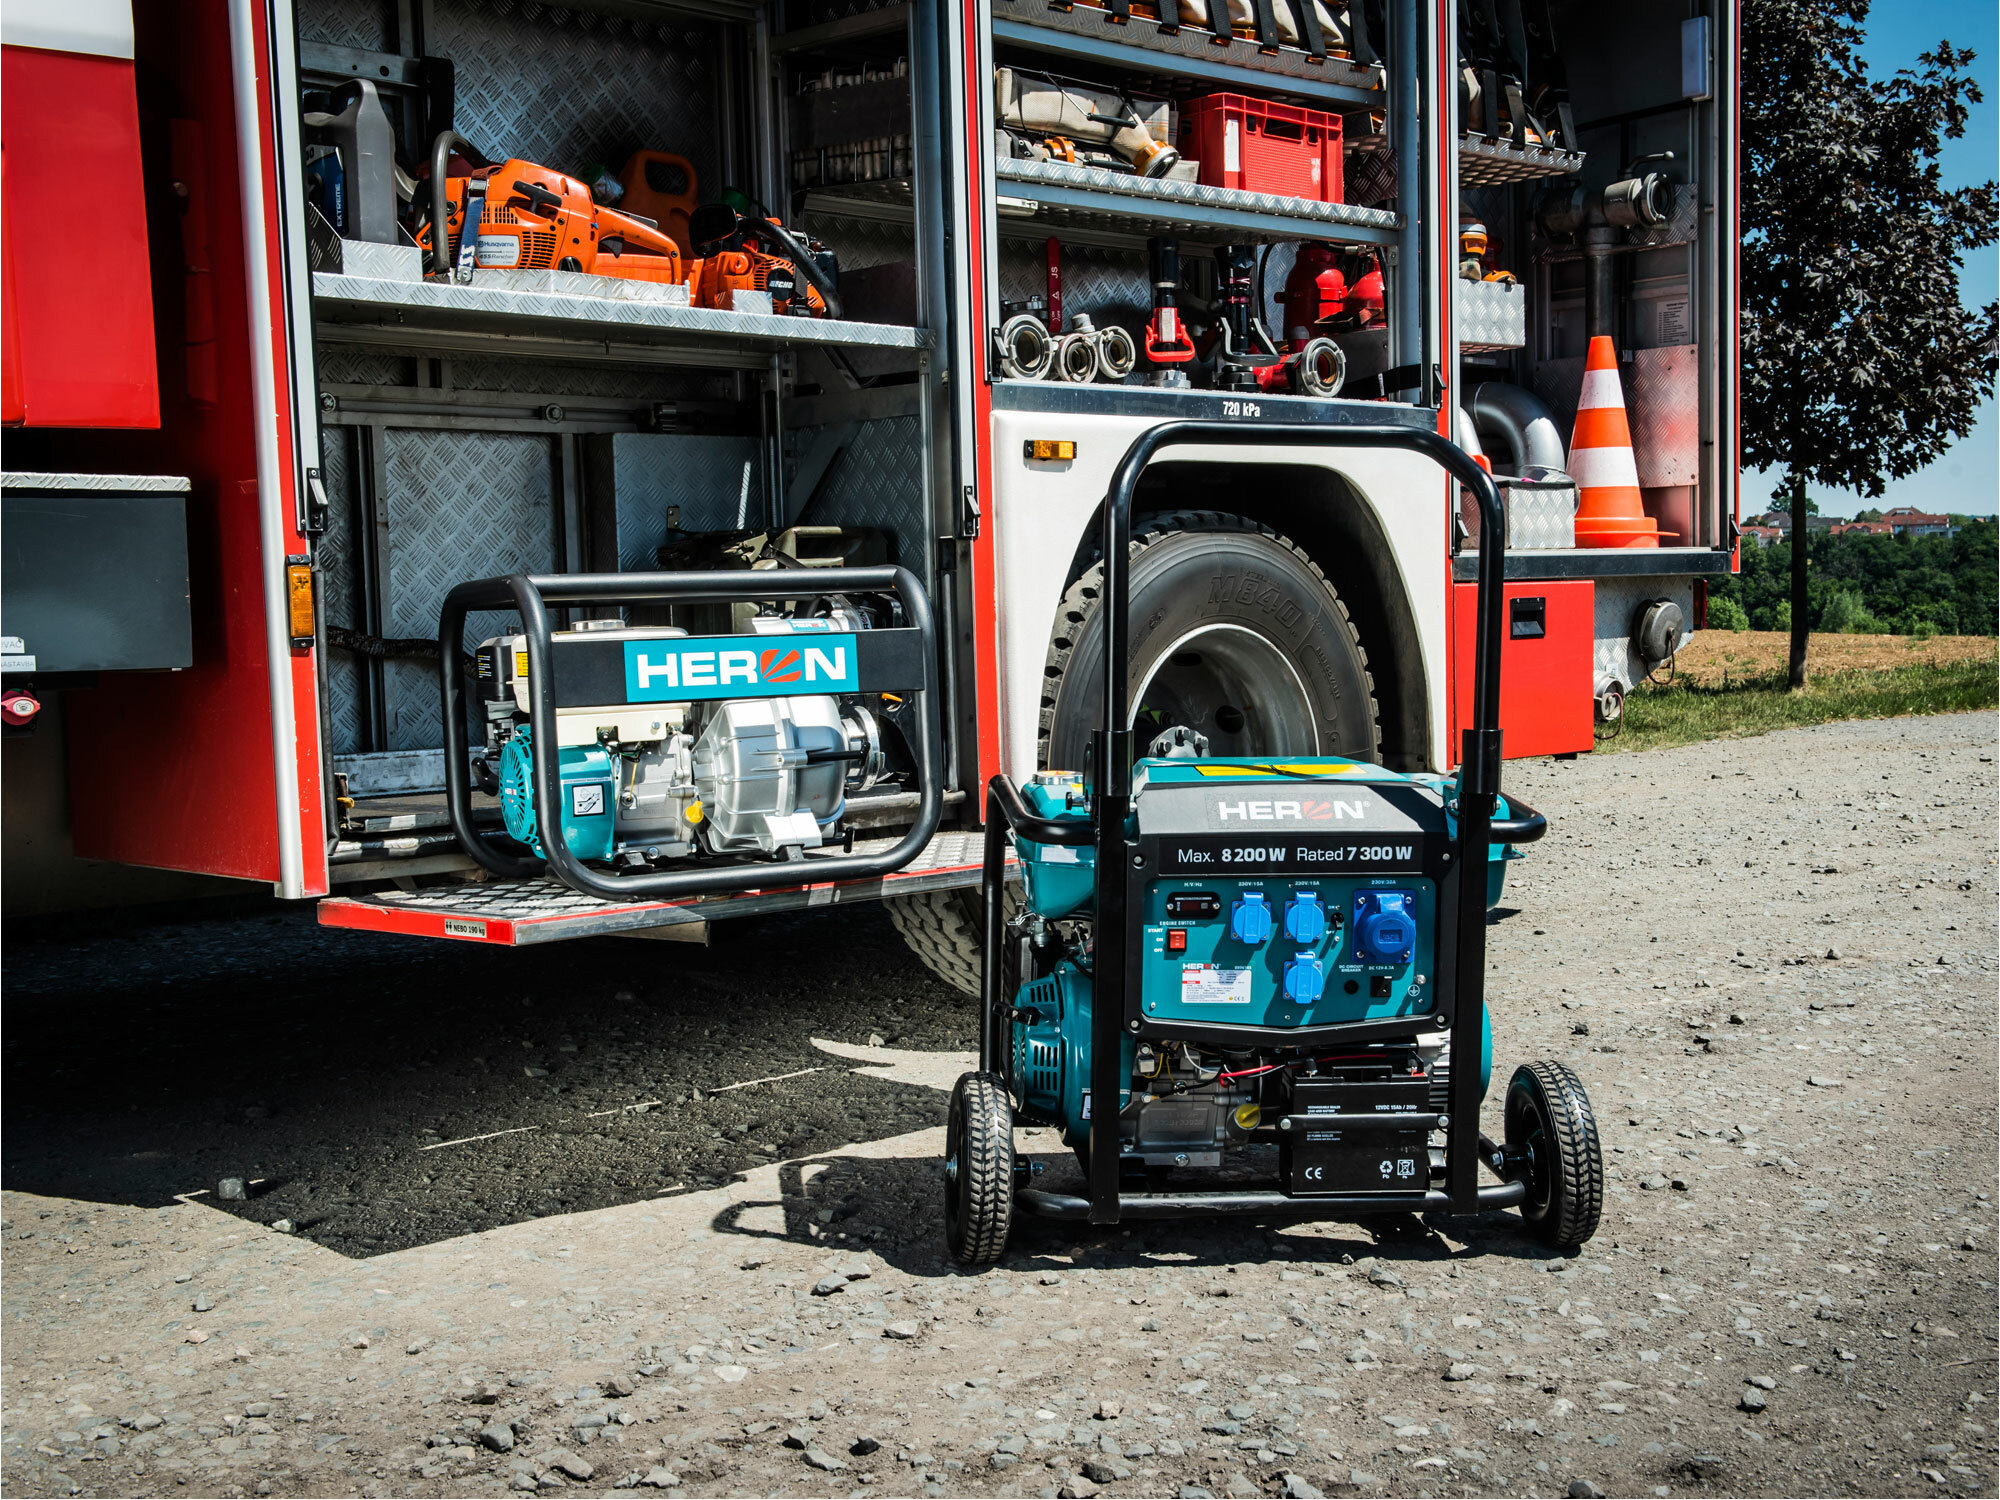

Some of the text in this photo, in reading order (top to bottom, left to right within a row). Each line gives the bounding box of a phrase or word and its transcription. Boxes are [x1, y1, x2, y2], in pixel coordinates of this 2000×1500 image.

[1051, 266, 1058, 279] JS
[769, 280, 794, 289] ECHO
[1222, 401, 1260, 417] 720 kPa
[1208, 575, 1302, 629] M840
[637, 647, 847, 689] HERON
[1218, 800, 1366, 820] HERON
[1178, 849, 1215, 863] Max.
[1297, 847, 1343, 861] Rated
[453, 924, 468, 933] NEBO
[478, 928, 486, 937] kg
